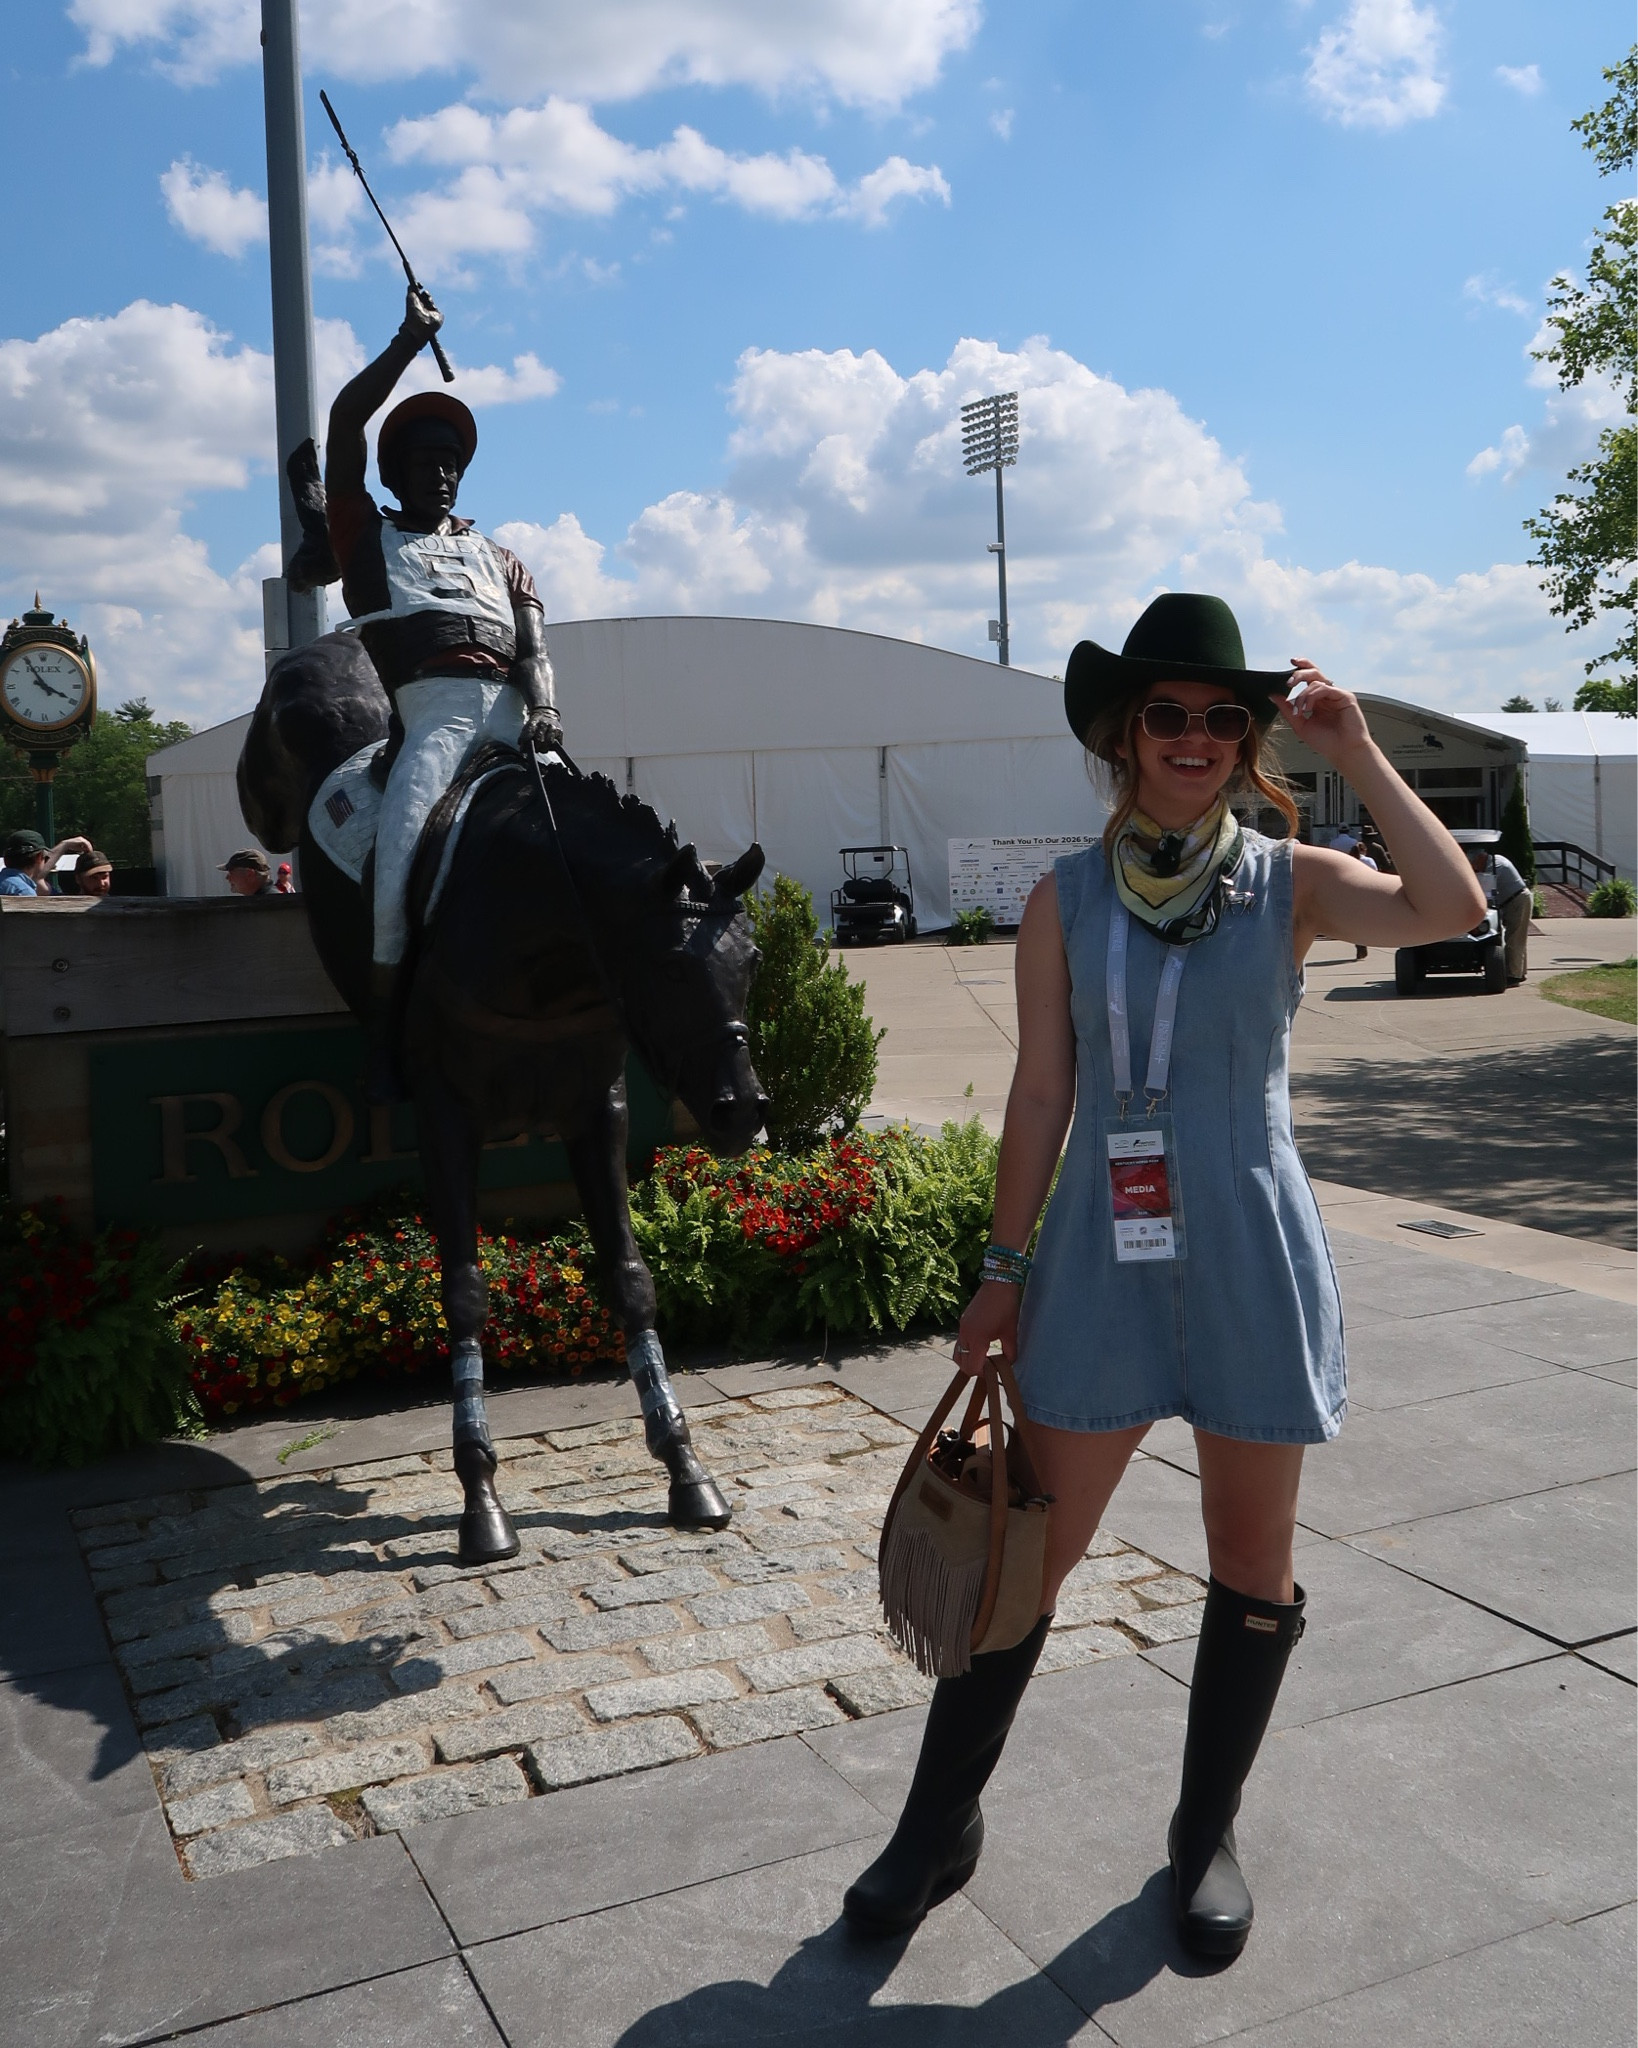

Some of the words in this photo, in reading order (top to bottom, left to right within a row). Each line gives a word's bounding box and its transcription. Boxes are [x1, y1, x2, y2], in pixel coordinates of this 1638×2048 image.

[403, 535, 489, 554] ROLEX
[992, 838, 1015, 846] Thank
[1083, 835, 1099, 844] Spo
[148, 1080, 560, 1184] ROL
[1124, 1184, 1156, 1195] MEDIA
